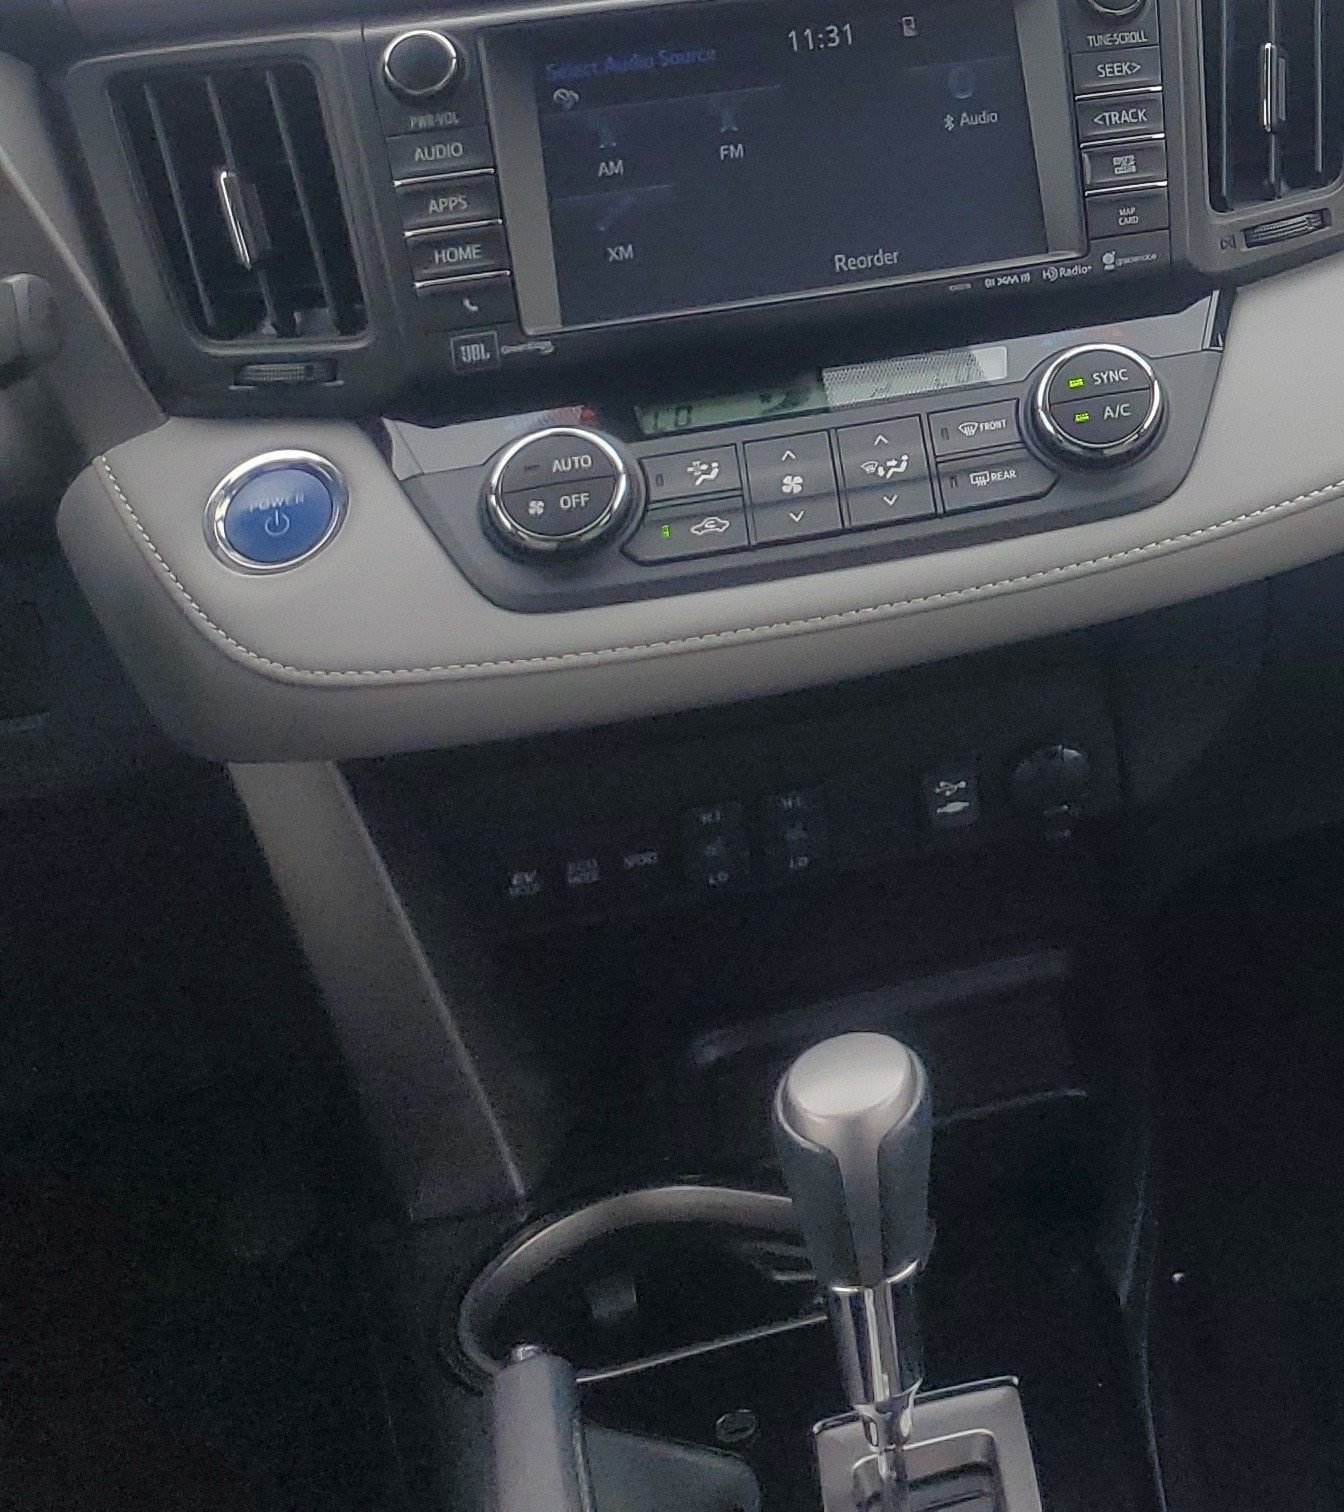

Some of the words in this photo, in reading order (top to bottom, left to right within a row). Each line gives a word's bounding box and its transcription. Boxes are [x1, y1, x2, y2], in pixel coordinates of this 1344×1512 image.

[788, 23, 852, 53] 11:31
[658, 49, 717, 67] Source
[960, 110, 998, 127] Audio
[414, 141, 463, 163] AUDIO
[719, 143, 744, 161] FM
[597, 159, 624, 178] AM
[428, 194, 468, 215] APPS
[433, 243, 482, 265] HOME
[606, 244, 634, 263] XM
[834, 248, 899, 273] Reorder
[460, 342, 491, 363] JBL
[1092, 368, 1129, 385] SYNC
[1103, 403, 1132, 420] A/C
[979, 418, 1007, 432] FRONT
[551, 454, 593, 473] AUTO
[990, 470, 1017, 481] REAR
[249, 492, 305, 513] POWER
[559, 492, 590, 510] OFF
